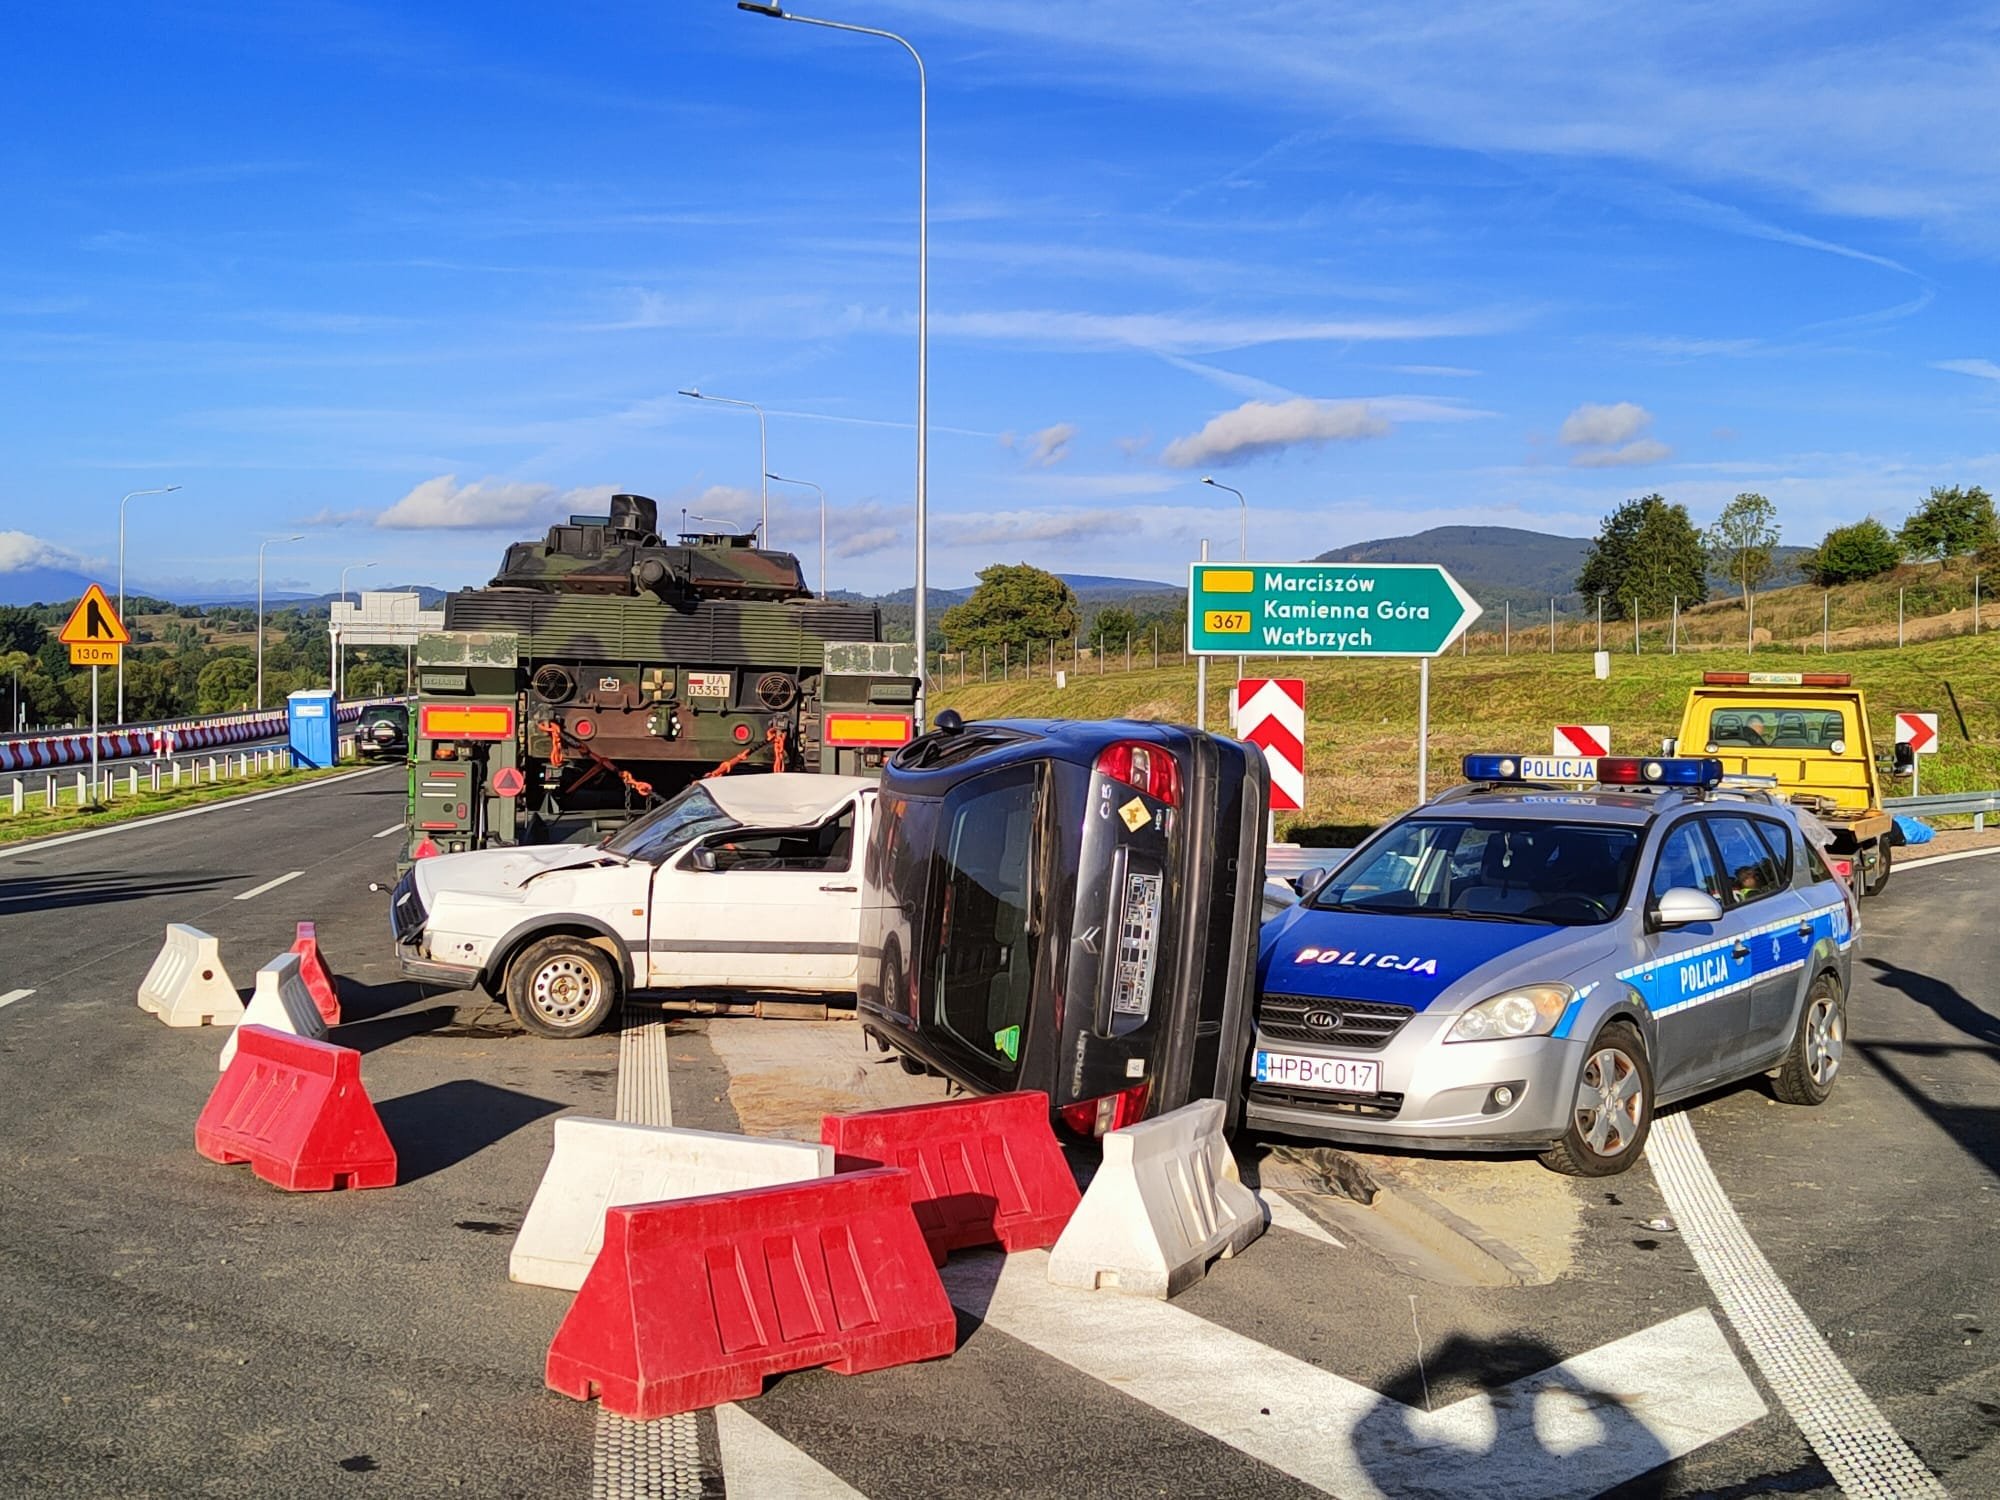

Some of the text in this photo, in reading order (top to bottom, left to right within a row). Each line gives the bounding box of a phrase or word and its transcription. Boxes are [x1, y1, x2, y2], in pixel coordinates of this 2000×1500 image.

[1264, 572, 1376, 593] Marciszów
[1263, 599, 1430, 620] Kamienna Góra
[1213, 614, 1243, 629] 367
[1262, 626, 1373, 651] Wałbrzych
[77, 648, 113, 660] 130 m
[688, 685, 728, 696] 0335T
[706, 675, 725, 685] UA
[1523, 760, 1594, 778] POLICJA
[1100, 783, 1112, 819] C5
[1294, 948, 1437, 975] POLICJA
[1680, 954, 1729, 995] POLICJA
[1310, 1013, 1333, 1026] KIA
[1268, 1056, 1373, 1087] HPB C017
